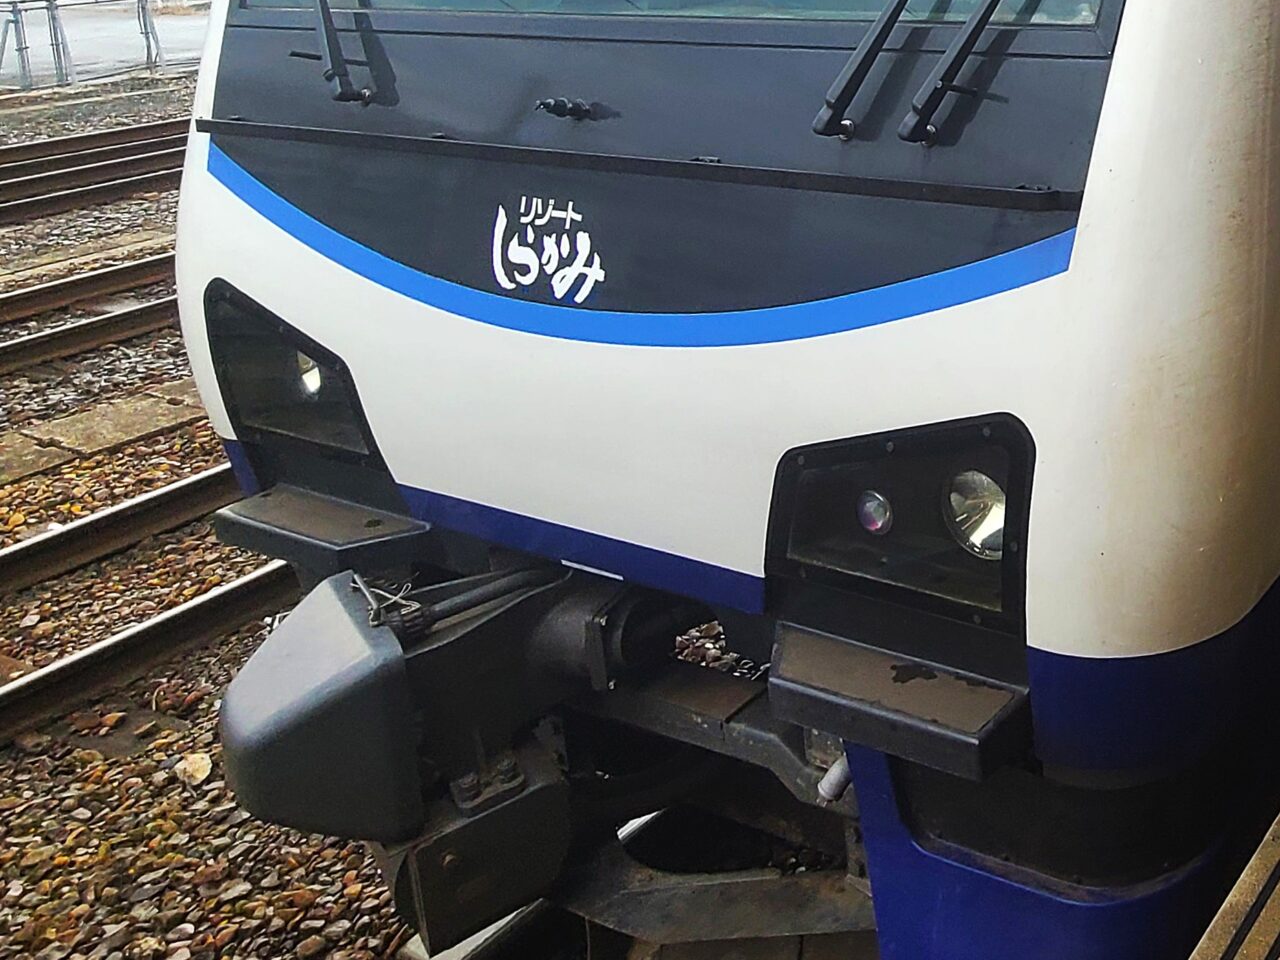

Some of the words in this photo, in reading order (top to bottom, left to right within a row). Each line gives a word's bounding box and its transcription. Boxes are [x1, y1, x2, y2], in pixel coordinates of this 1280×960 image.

[519, 195, 583, 230] リゾート
[492, 203, 606, 304] しらかみ
